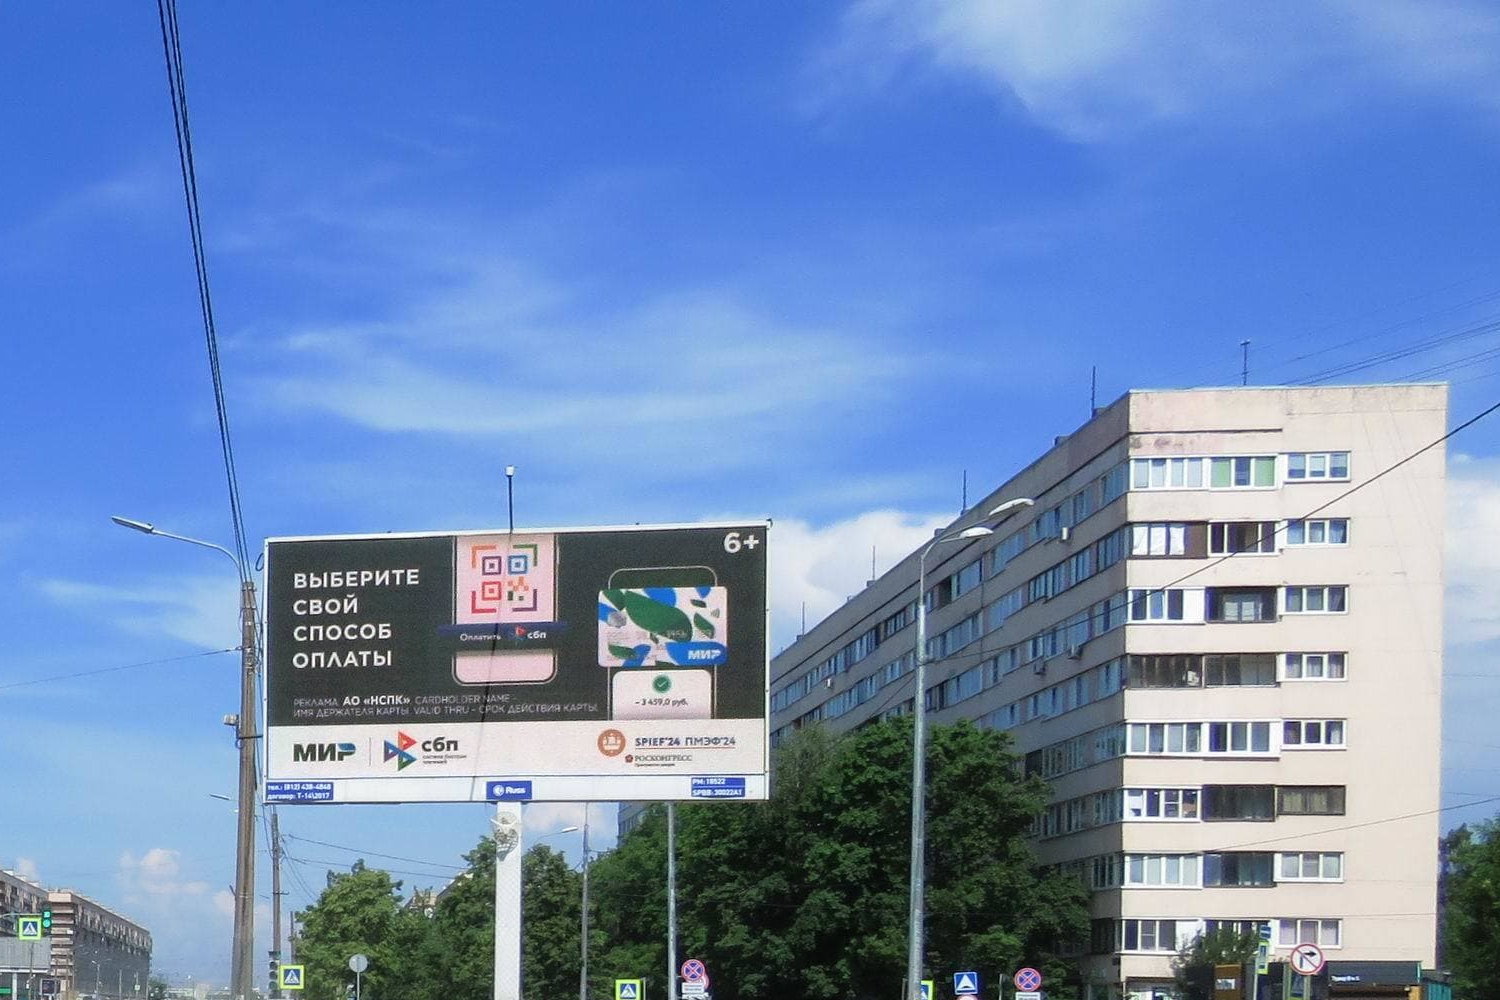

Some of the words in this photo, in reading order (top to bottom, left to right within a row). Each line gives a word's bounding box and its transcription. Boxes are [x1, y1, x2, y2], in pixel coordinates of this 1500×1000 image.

[723, 532, 760, 554] 6+
[293, 568, 421, 590] ВЫБЕРИТЕ
[293, 594, 359, 616] СВОЙ
[293, 623, 392, 642] СПОСОБ
[459, 632, 502, 643] Оплатить
[292, 650, 393, 669] ОПЛАТЫ
[688, 649, 721, 661] МИР
[343, 696, 361, 706] АО
[414, 694, 481, 705] CARDHOLDER
[484, 693, 511, 704] NAME
[293, 708, 314, 718] ИМЯ
[316, 707, 374, 719] ДЕРЖАТЕЛЯ
[414, 705, 441, 716] VALID
[444, 705, 469, 715] THRU
[479, 704, 505, 715] СРОК
[508, 703, 561, 714] ДЕЙСТВИЯ
[293, 742, 357, 762] МИР
[421, 736, 459, 753] сбп
